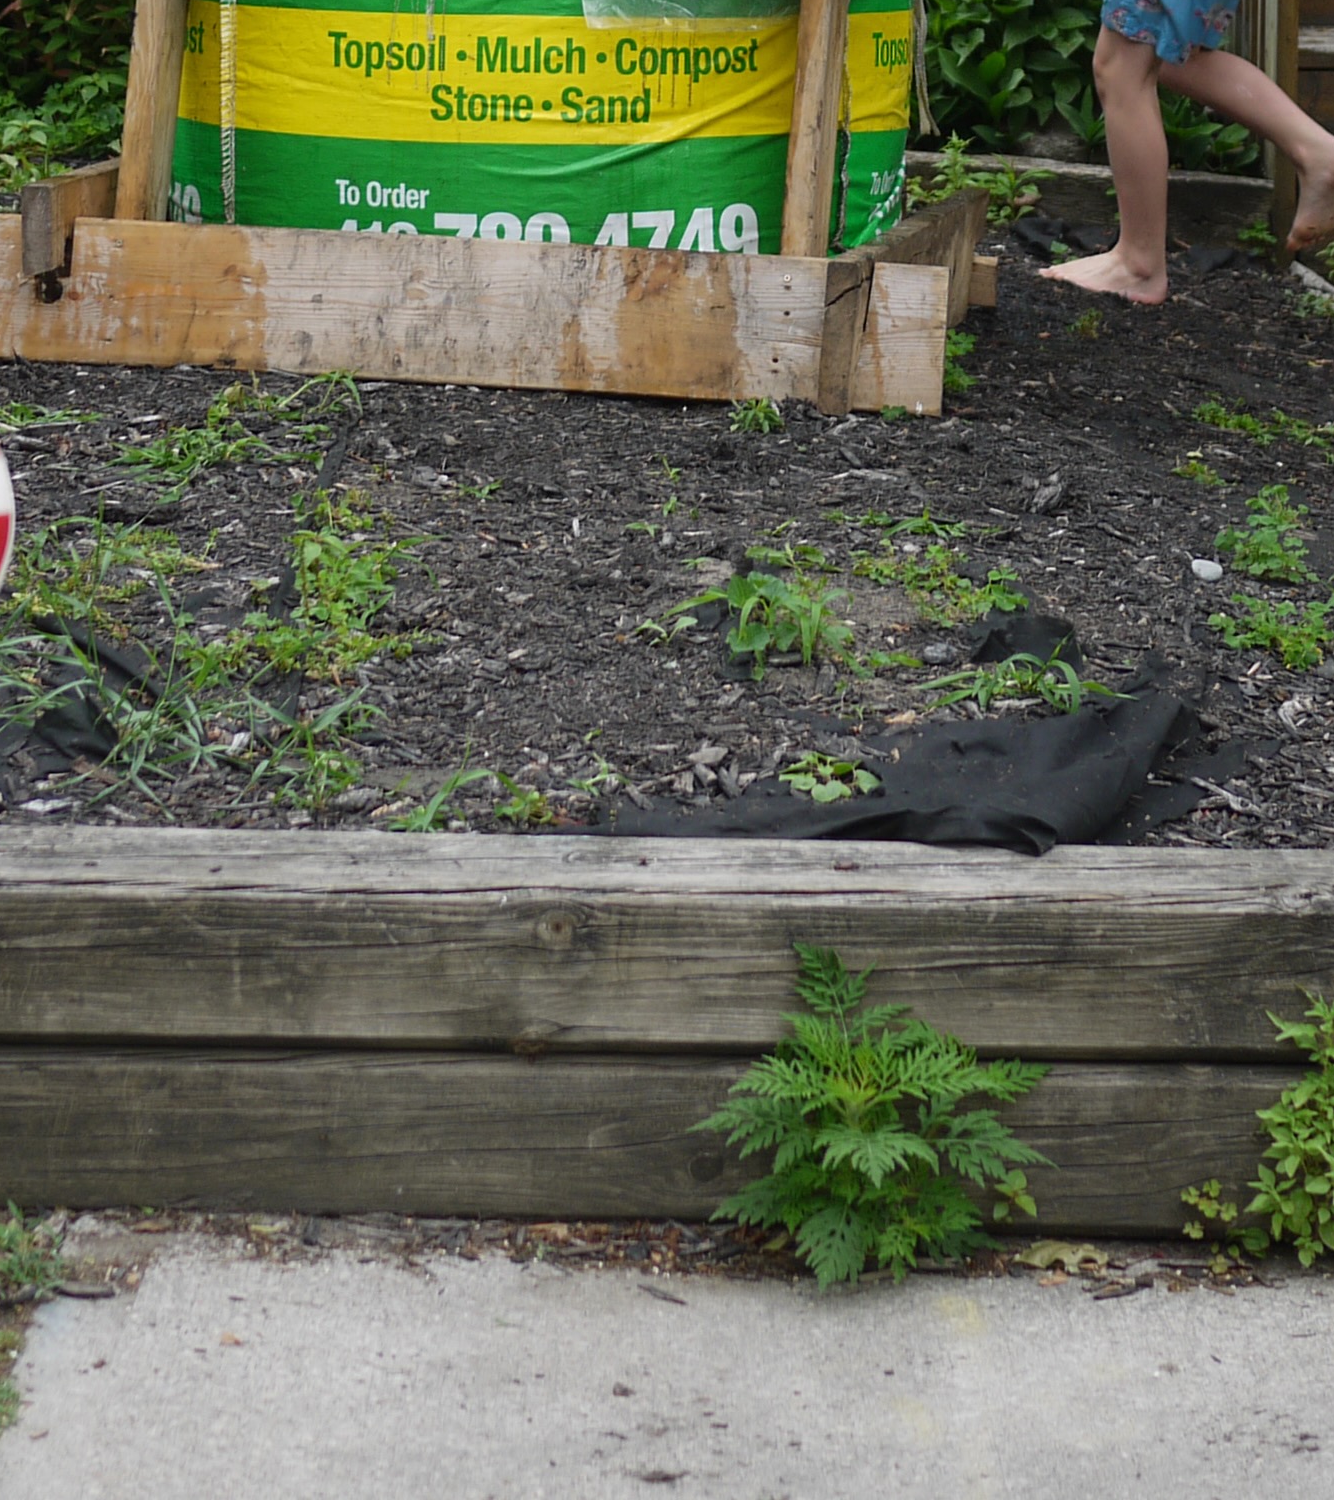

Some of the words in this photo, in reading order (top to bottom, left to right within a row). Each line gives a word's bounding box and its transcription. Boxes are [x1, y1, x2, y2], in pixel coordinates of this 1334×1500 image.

[328, 30, 447, 77] Topsoil
[475, 34, 588, 75] Mulch
[614, 36, 760, 83] Compost
[429, 83, 534, 123] Stone
[559, 86, 651, 124] Sand
[335, 178, 360, 206] To
[366, 181, 430, 210] Order
